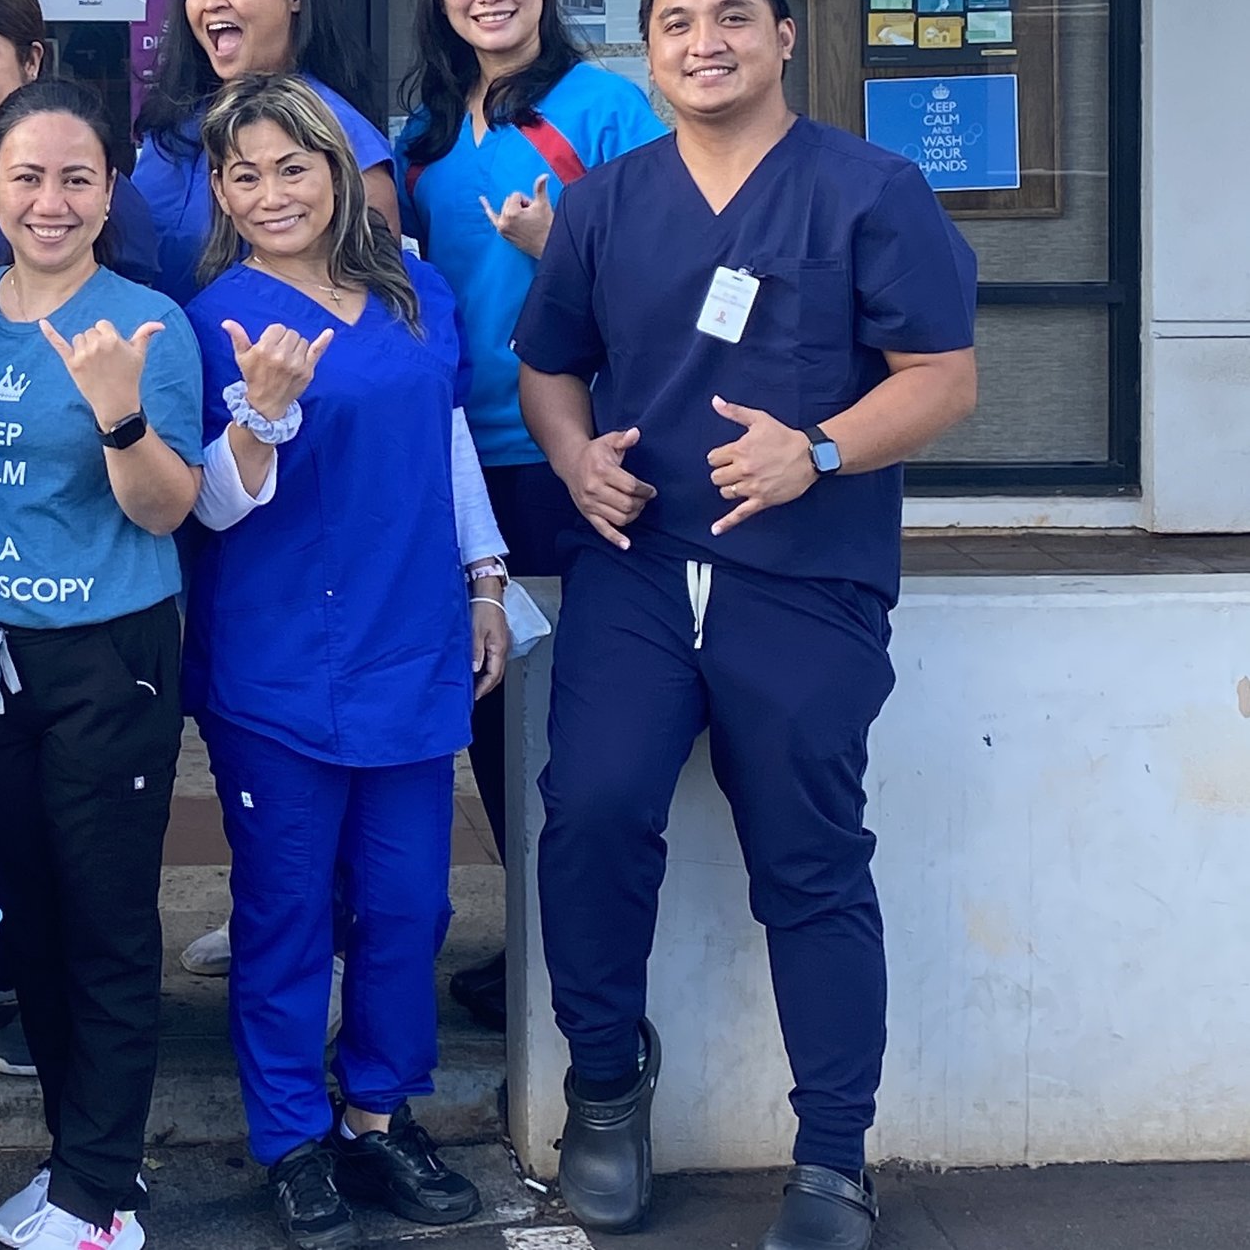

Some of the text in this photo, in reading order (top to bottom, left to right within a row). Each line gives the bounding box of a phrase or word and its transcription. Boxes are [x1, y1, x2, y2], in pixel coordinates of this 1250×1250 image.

[926, 101, 957, 113] KEEP
[923, 114, 960, 126] CALM
[931, 126, 952, 135] AND
[921, 135, 962, 147] WASH
[923, 147, 962, 160] YOUR
[918, 160, 968, 172] HANDS
